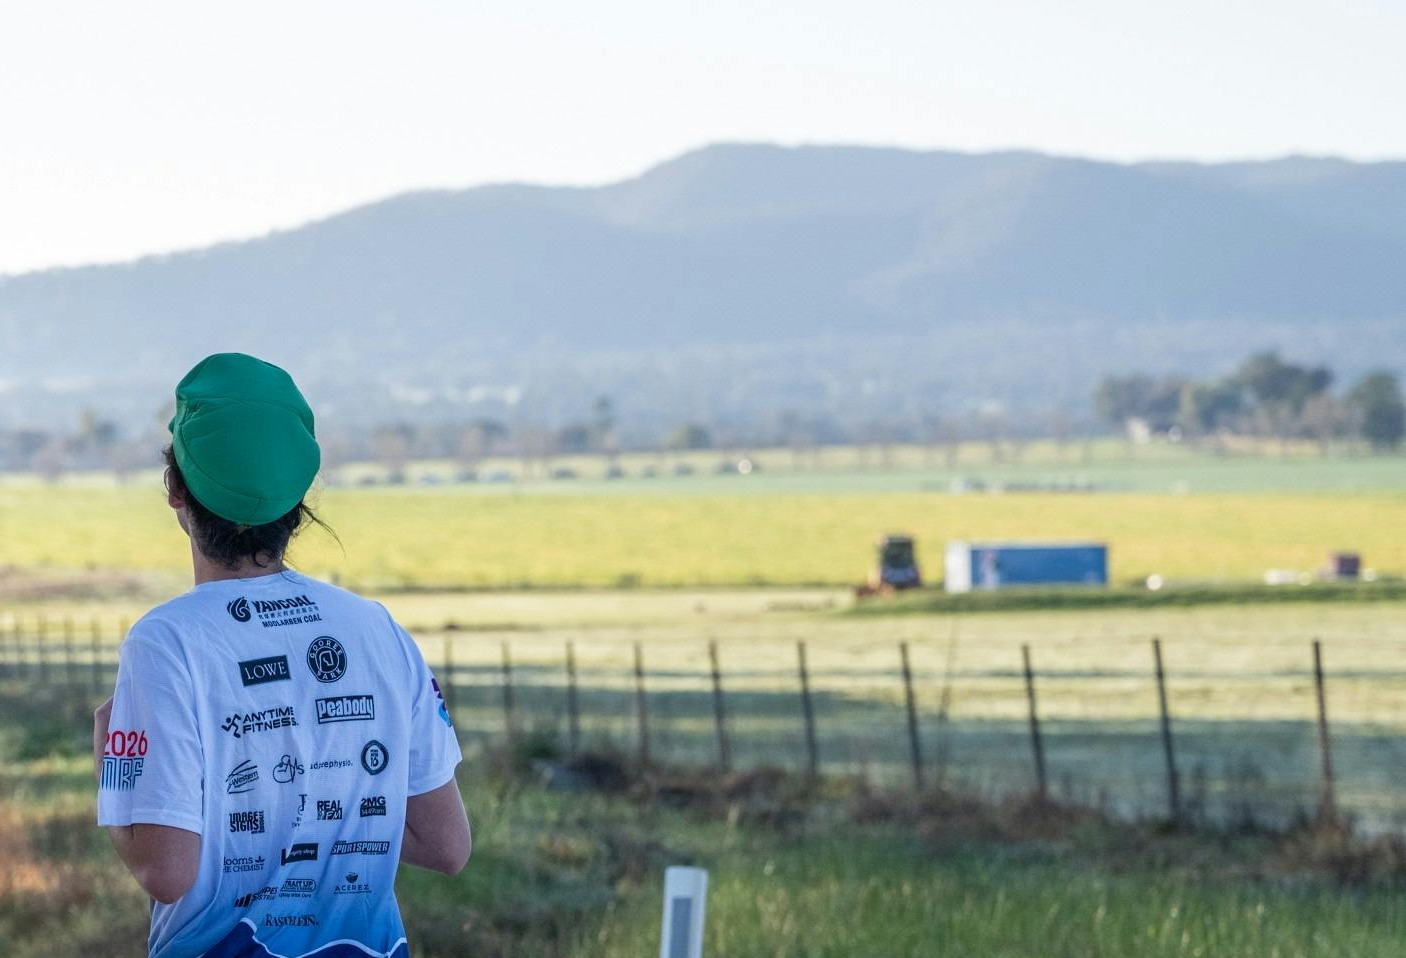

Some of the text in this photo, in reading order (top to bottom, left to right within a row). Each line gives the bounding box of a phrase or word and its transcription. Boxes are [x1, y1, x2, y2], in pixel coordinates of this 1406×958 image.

[252, 595, 316, 613] YANCOAL
[262, 613, 323, 628] MOOLARBEN COAL
[310, 640, 343, 659] GOOREE
[245, 661, 287, 680] LOWE
[318, 669, 342, 680] PARK
[317, 697, 374, 718] Peabody
[317, 800, 340, 812] REAL
[361, 796, 386, 807] 2MG
[331, 842, 389, 853] SPORTSPOWER
[223, 856, 254, 866] looms
[233, 864, 264, 873] CHEMIST
